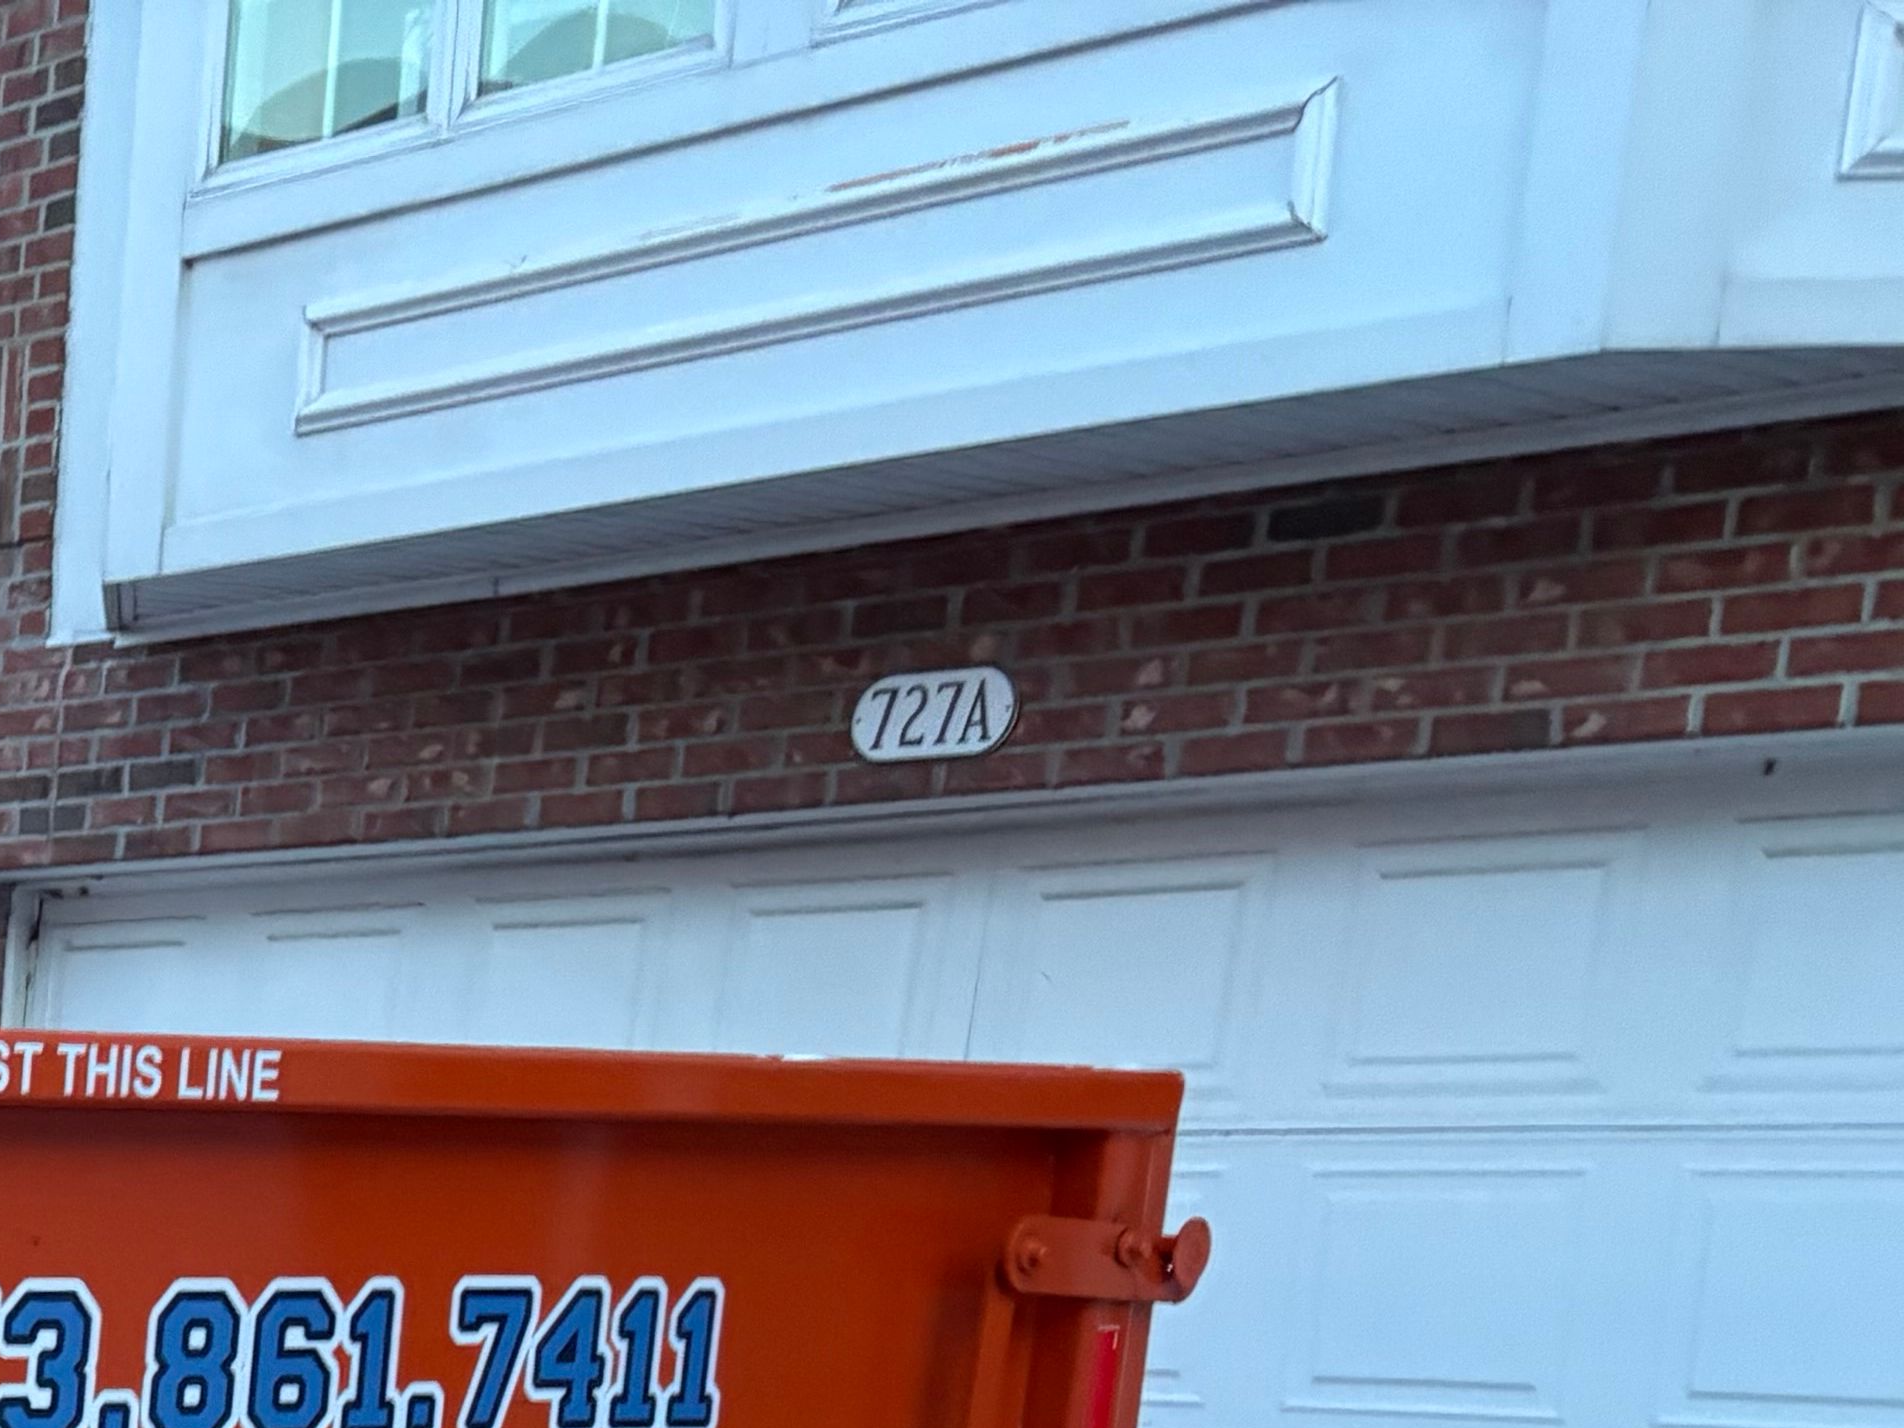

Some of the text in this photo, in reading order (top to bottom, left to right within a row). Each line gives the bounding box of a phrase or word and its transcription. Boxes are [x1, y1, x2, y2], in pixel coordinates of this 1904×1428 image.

[869, 677, 991, 750] 727A
[56, 1041, 164, 1097] THIS
[177, 1046, 283, 1101] LINE
